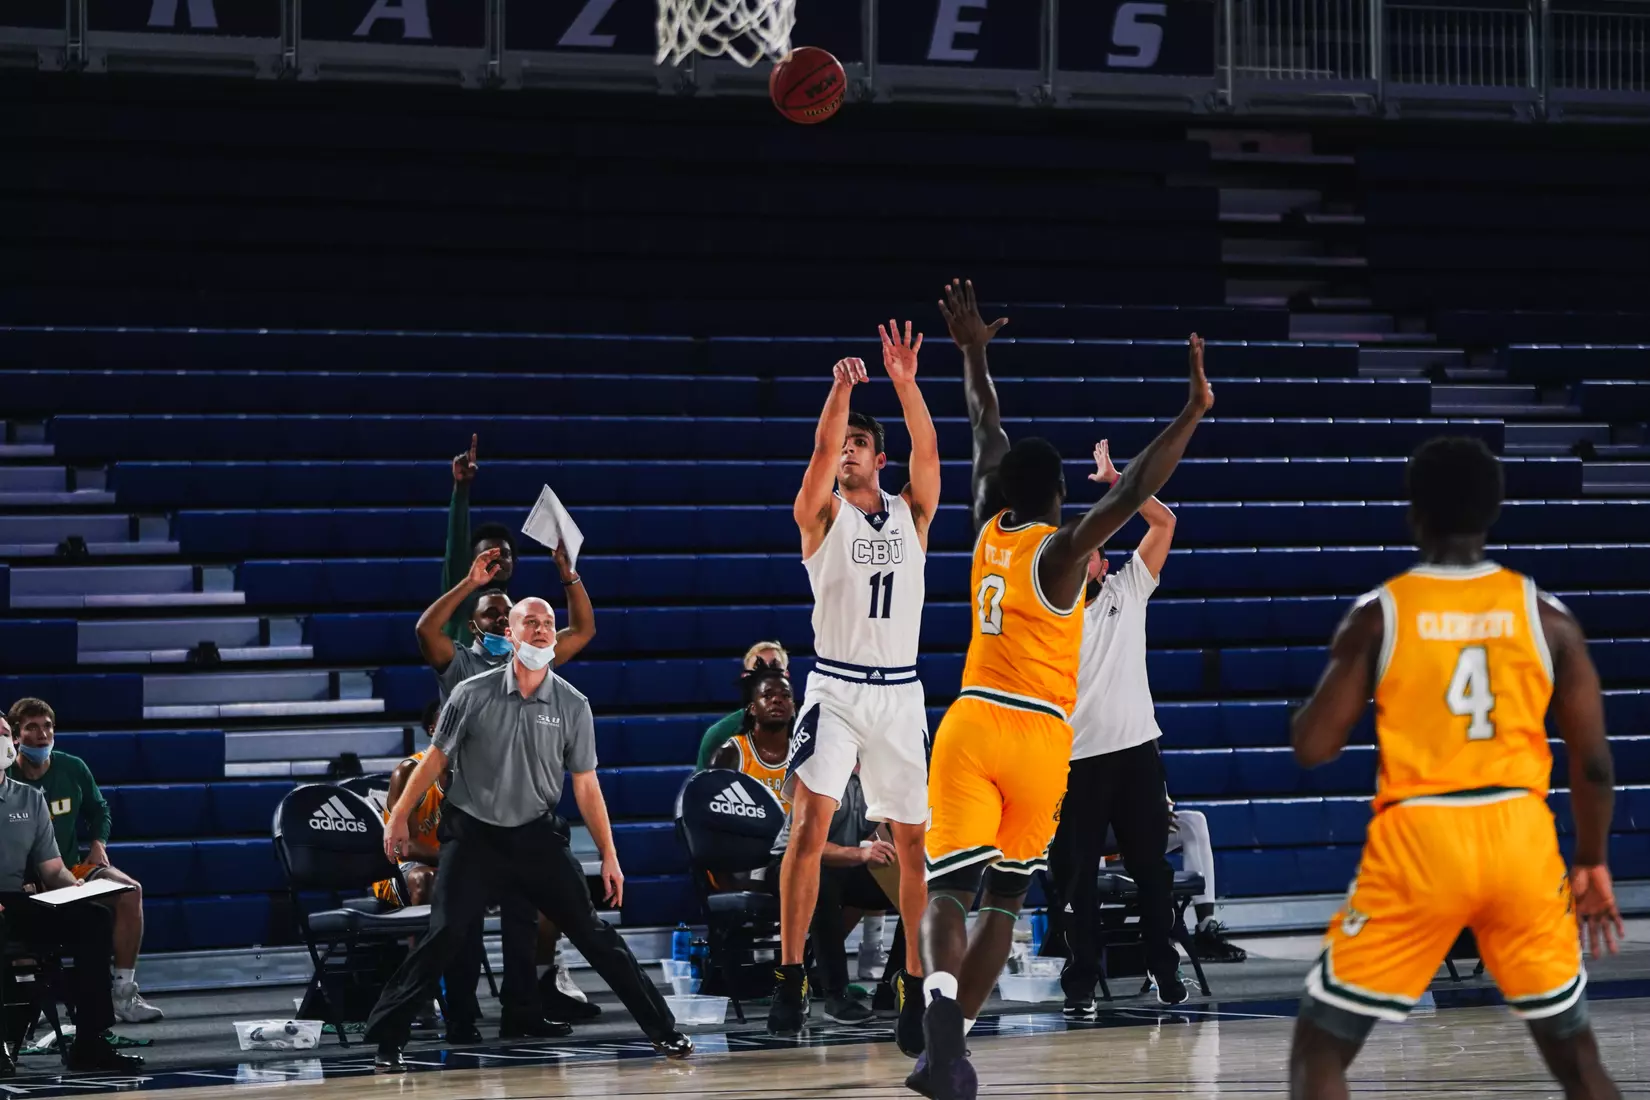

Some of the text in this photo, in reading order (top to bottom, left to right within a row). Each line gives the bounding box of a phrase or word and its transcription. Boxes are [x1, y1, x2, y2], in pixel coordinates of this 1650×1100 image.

[852, 538, 903, 565] CBU
[868, 571, 894, 619] 11
[977, 573, 1006, 636] 0
[1445, 645, 1496, 741] 4
[308, 816, 368, 833] adidas
[709, 799, 767, 819] adidas
